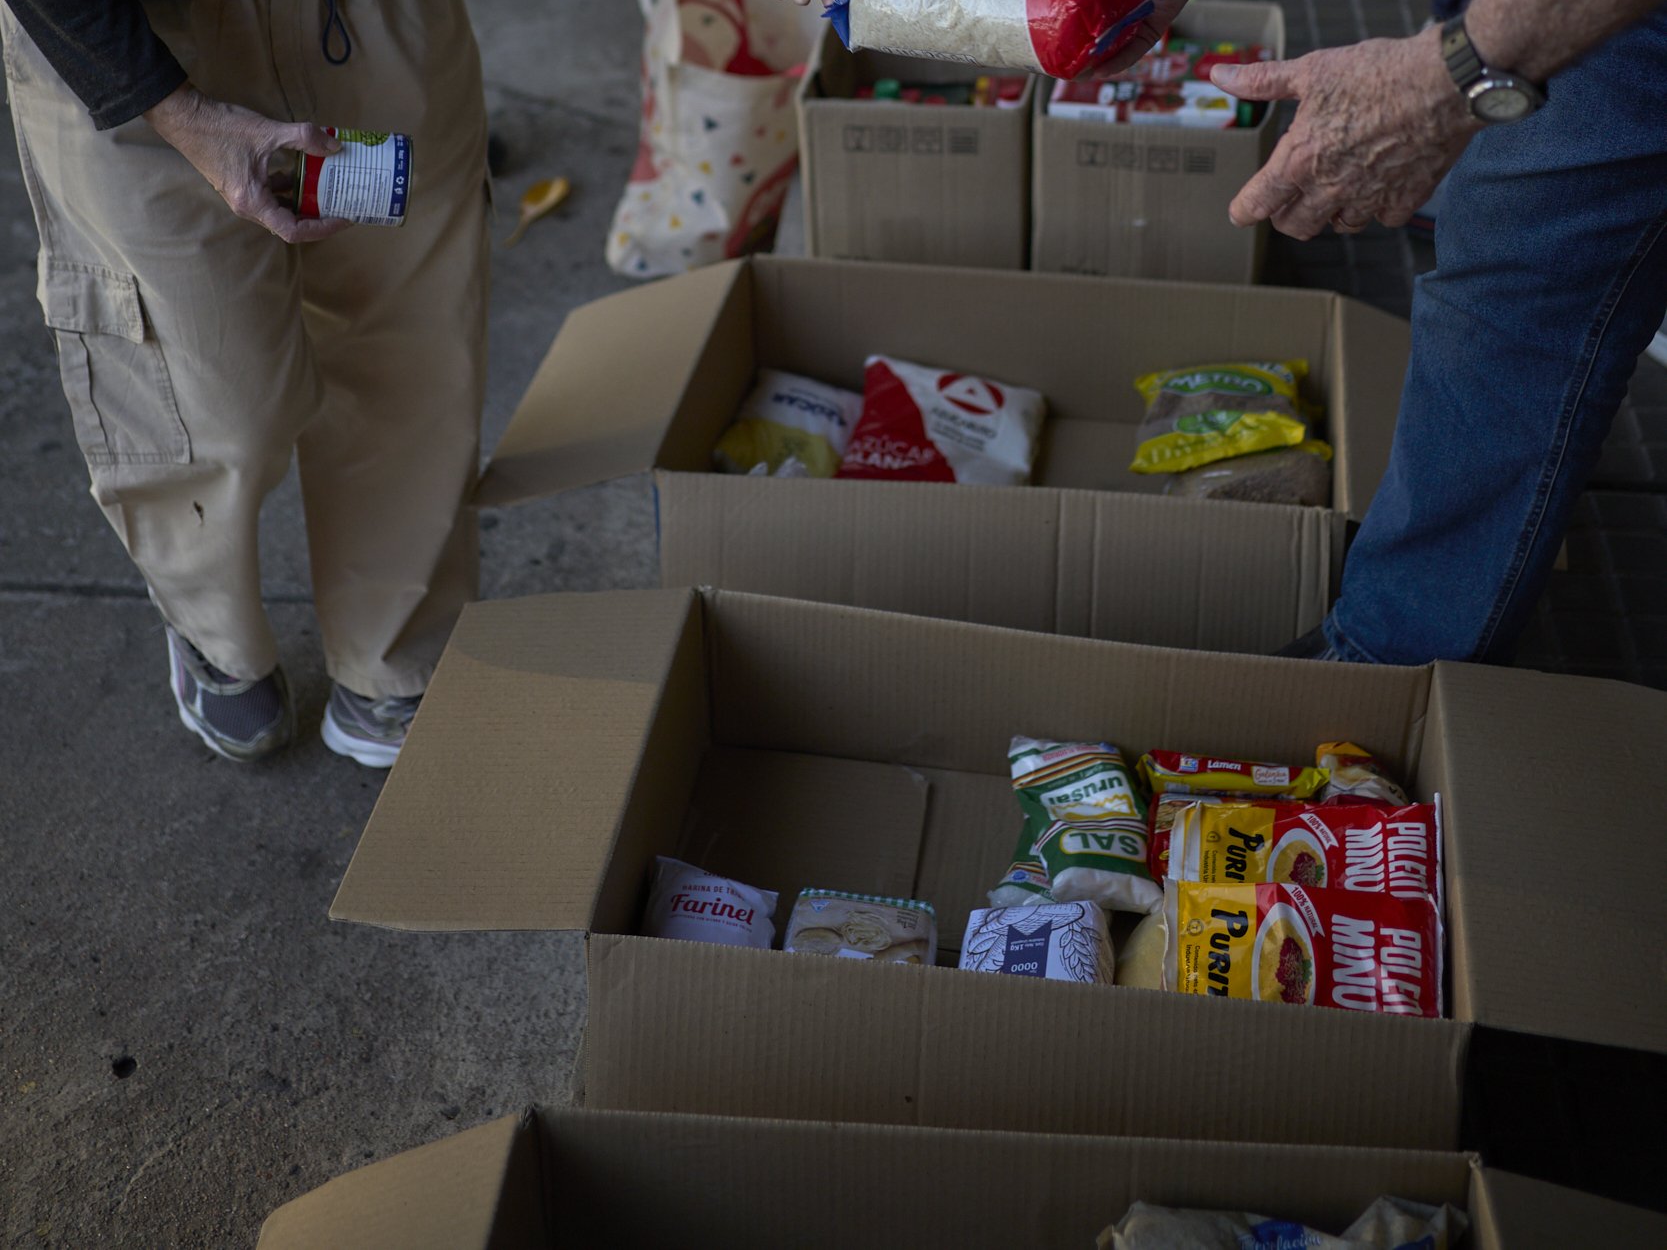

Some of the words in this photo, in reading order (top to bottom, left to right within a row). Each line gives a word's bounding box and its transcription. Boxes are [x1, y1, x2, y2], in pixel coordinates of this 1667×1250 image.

[1069, 832, 1140, 855] SAL
[1225, 827, 1265, 883] PURI
[1344, 821, 1385, 893] MINU
[671, 893, 757, 925] Farinel
[1291, 886, 1308, 907] 100%
[1303, 904, 1319, 929] NATURAL
[1011, 961, 1039, 973] 0000
[1193, 945, 1201, 972] Contenido
